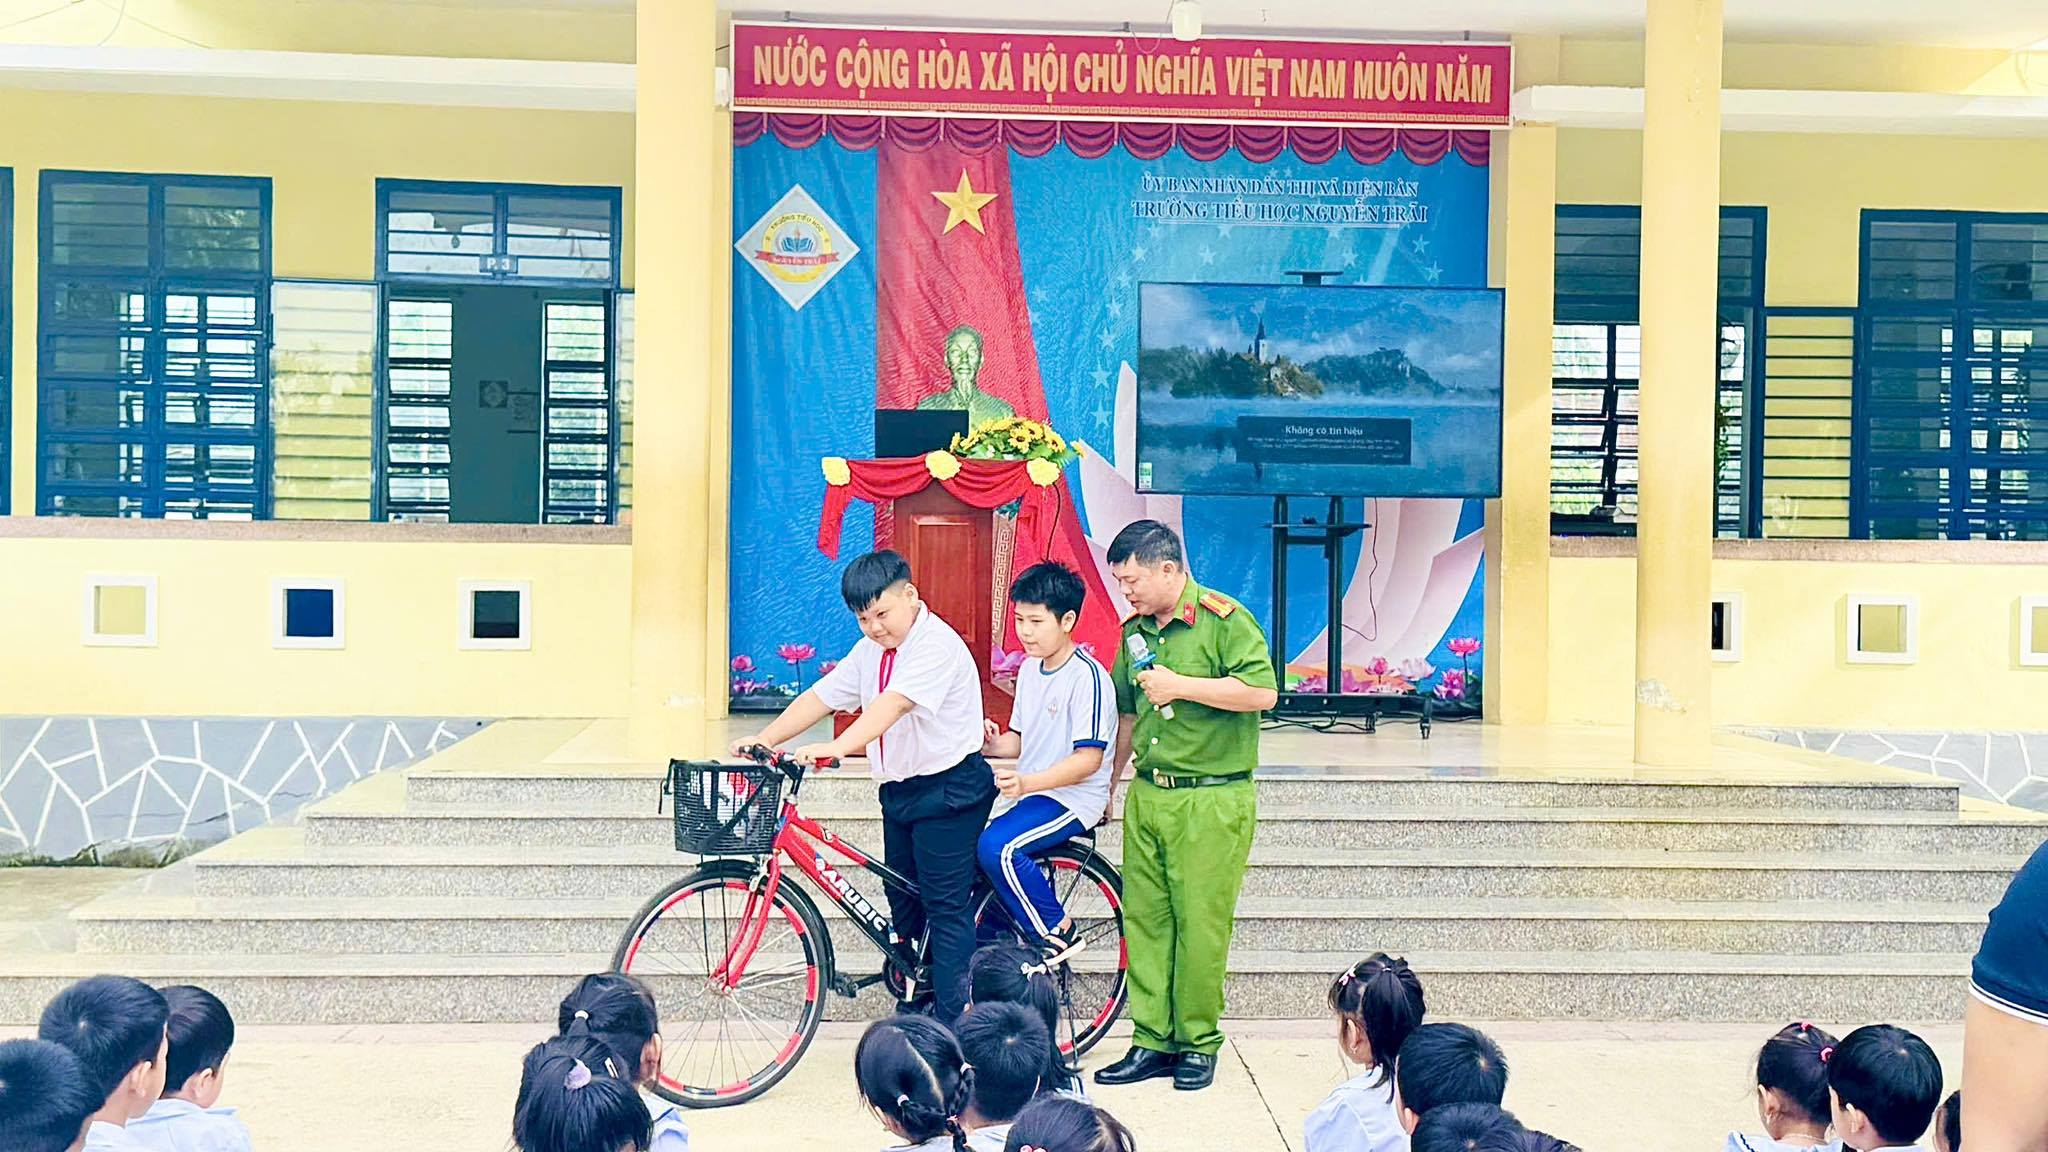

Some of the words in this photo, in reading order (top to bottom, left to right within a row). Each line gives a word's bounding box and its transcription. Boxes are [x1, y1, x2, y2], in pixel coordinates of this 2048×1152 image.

[753, 34, 827, 87] NƯỚC
[836, 38, 909, 99] CỘNG
[918, 38, 972, 90] HÒA
[979, 41, 1014, 91] XÃ
[1023, 41, 1067, 104] HỘI
[1074, 39, 1127, 95] CHỦ
[1136, 46, 1217, 96] NGHĨA
[1225, 49, 1284, 107] VIỆT
[1290, 58, 1347, 100] NAM
[1353, 51, 1427, 102] MUÔN
[1436, 54, 1491, 104] NĂM
[1167, 176, 1201, 193] BAN
[1203, 175, 1248, 195] NHÂN
[1251, 176, 1286, 195] DÂN
[1287, 179, 1315, 198] THỊ
[1317, 177, 1340, 196] XÃ
[1132, 196, 1208, 219] TRƯỜNG
[1212, 195, 1256, 220] TIỂU
[1260, 203, 1300, 224] HỌC
[1303, 197, 1381, 223] NGUYỄN
[1382, 201, 1428, 223] TRÃI
[487, 258, 498, 270] P.
[502, 258, 510, 270] 3
[1285, 425, 1314, 436] Không
